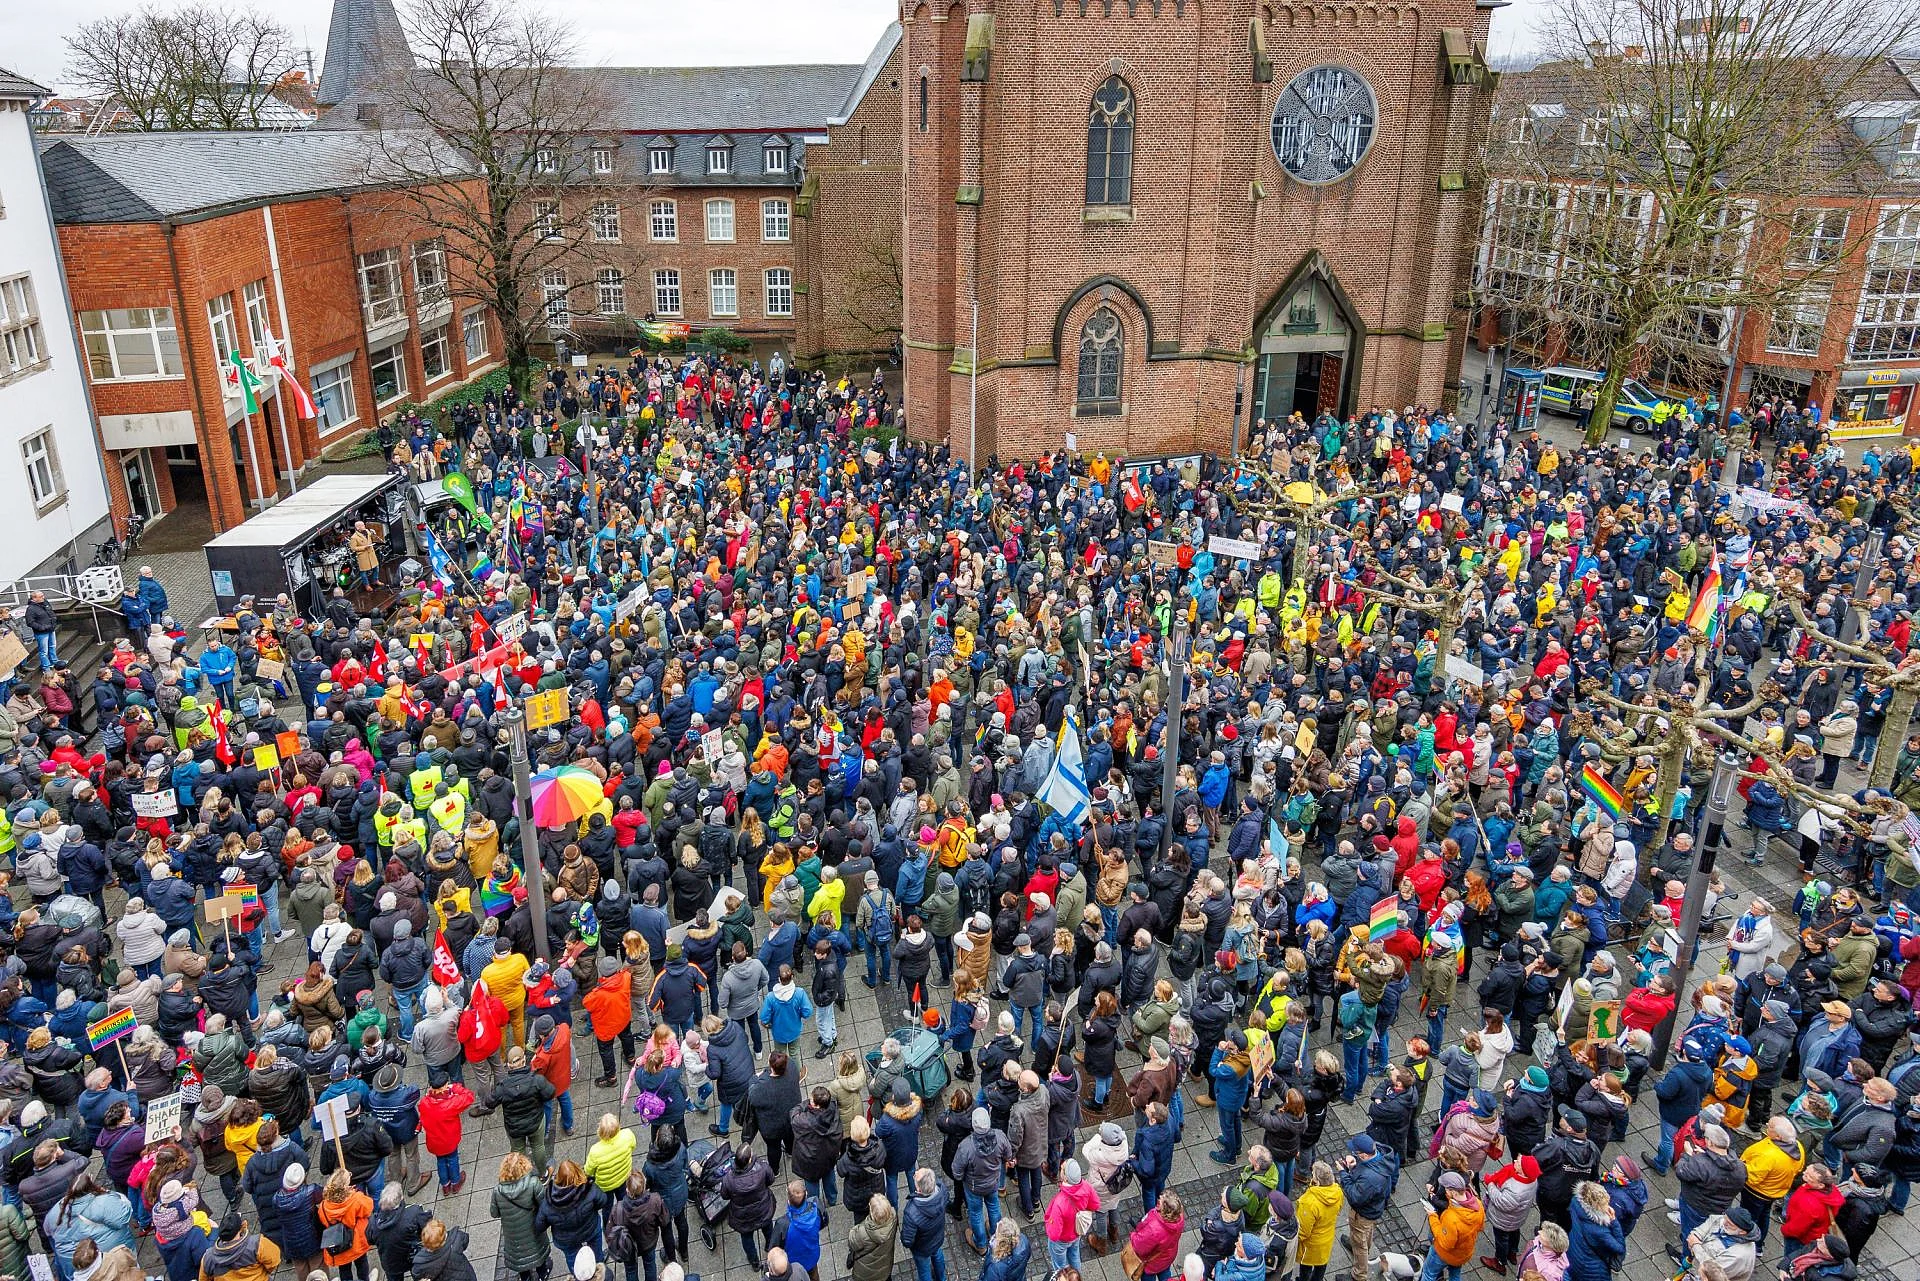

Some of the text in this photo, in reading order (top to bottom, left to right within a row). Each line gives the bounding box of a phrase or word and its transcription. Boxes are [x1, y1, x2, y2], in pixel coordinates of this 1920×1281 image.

[1546, 390, 1566, 399] POLIZEI
[434, 946, 459, 978] SPD
[94, 1015, 129, 1037] GEMEINSAM
[147, 1105, 180, 1125] SHAKE
[152, 1126, 170, 1140] OFF
[158, 1119, 168, 1130] IT
